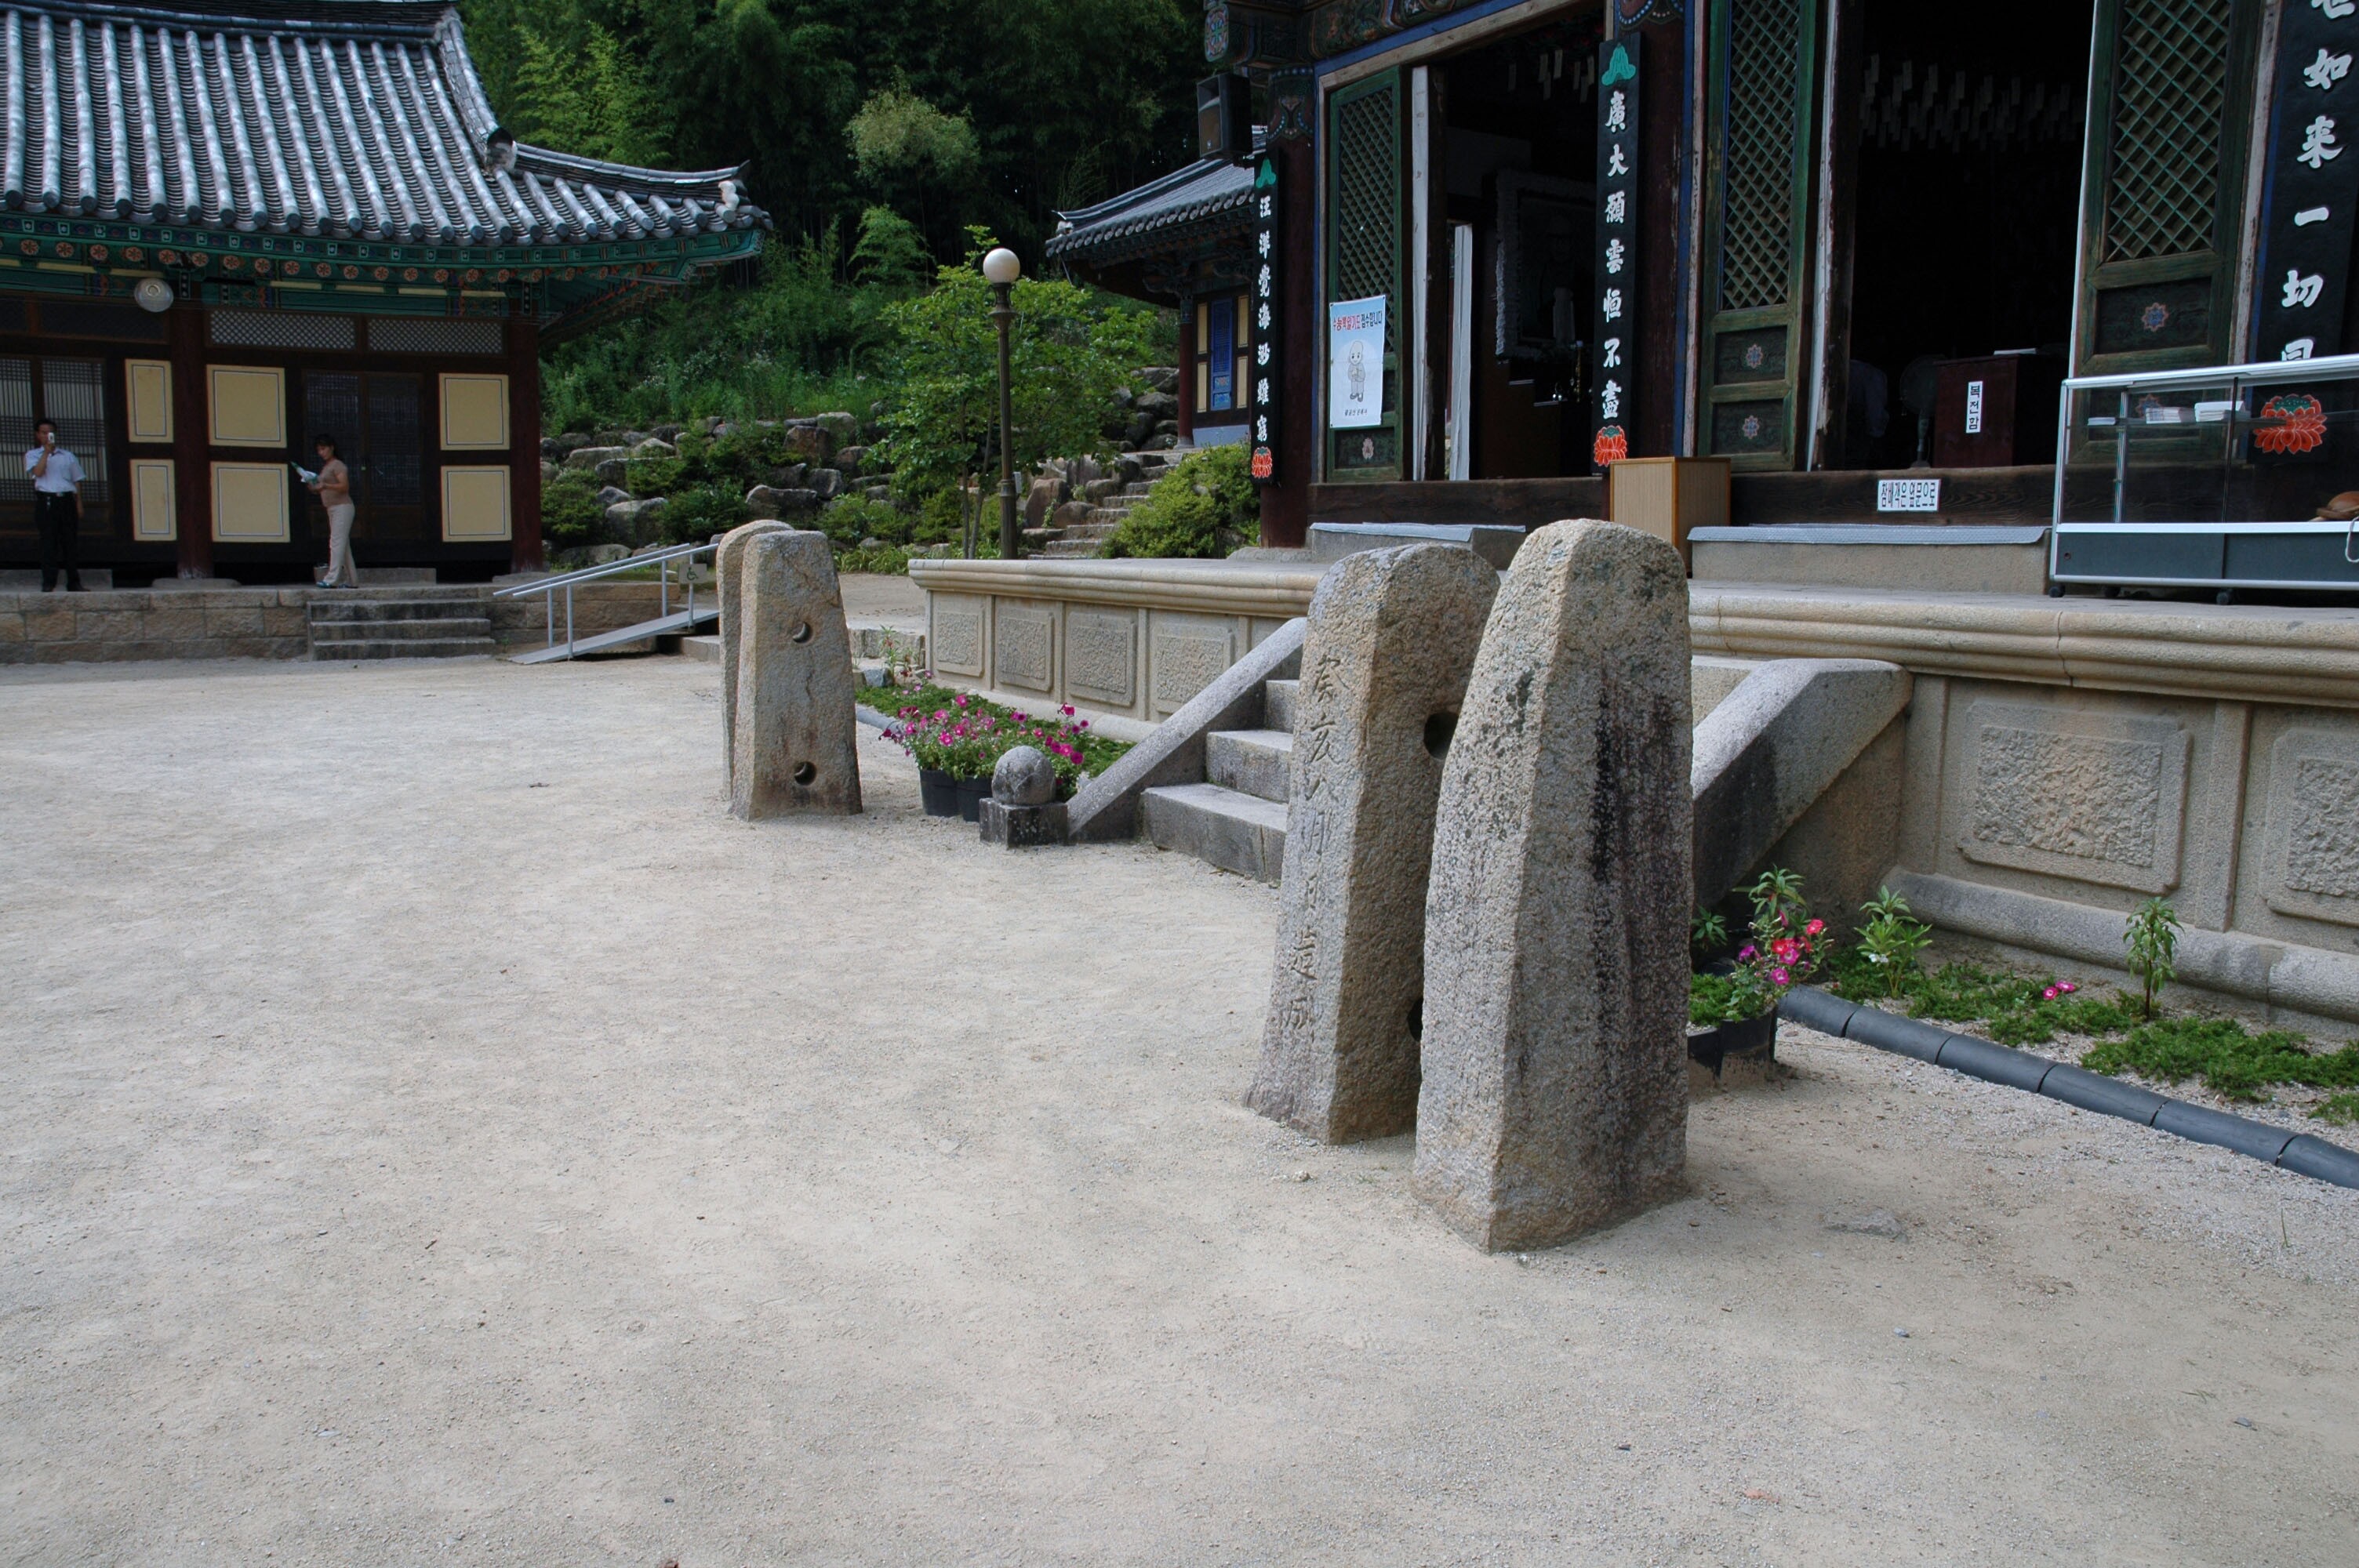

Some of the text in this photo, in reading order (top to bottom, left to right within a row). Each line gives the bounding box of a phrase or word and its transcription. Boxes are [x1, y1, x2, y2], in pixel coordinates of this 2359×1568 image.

[1968, 385, 1981, 430] 복전함
[1881, 481, 1936, 508] 참배객은 옆문으로
